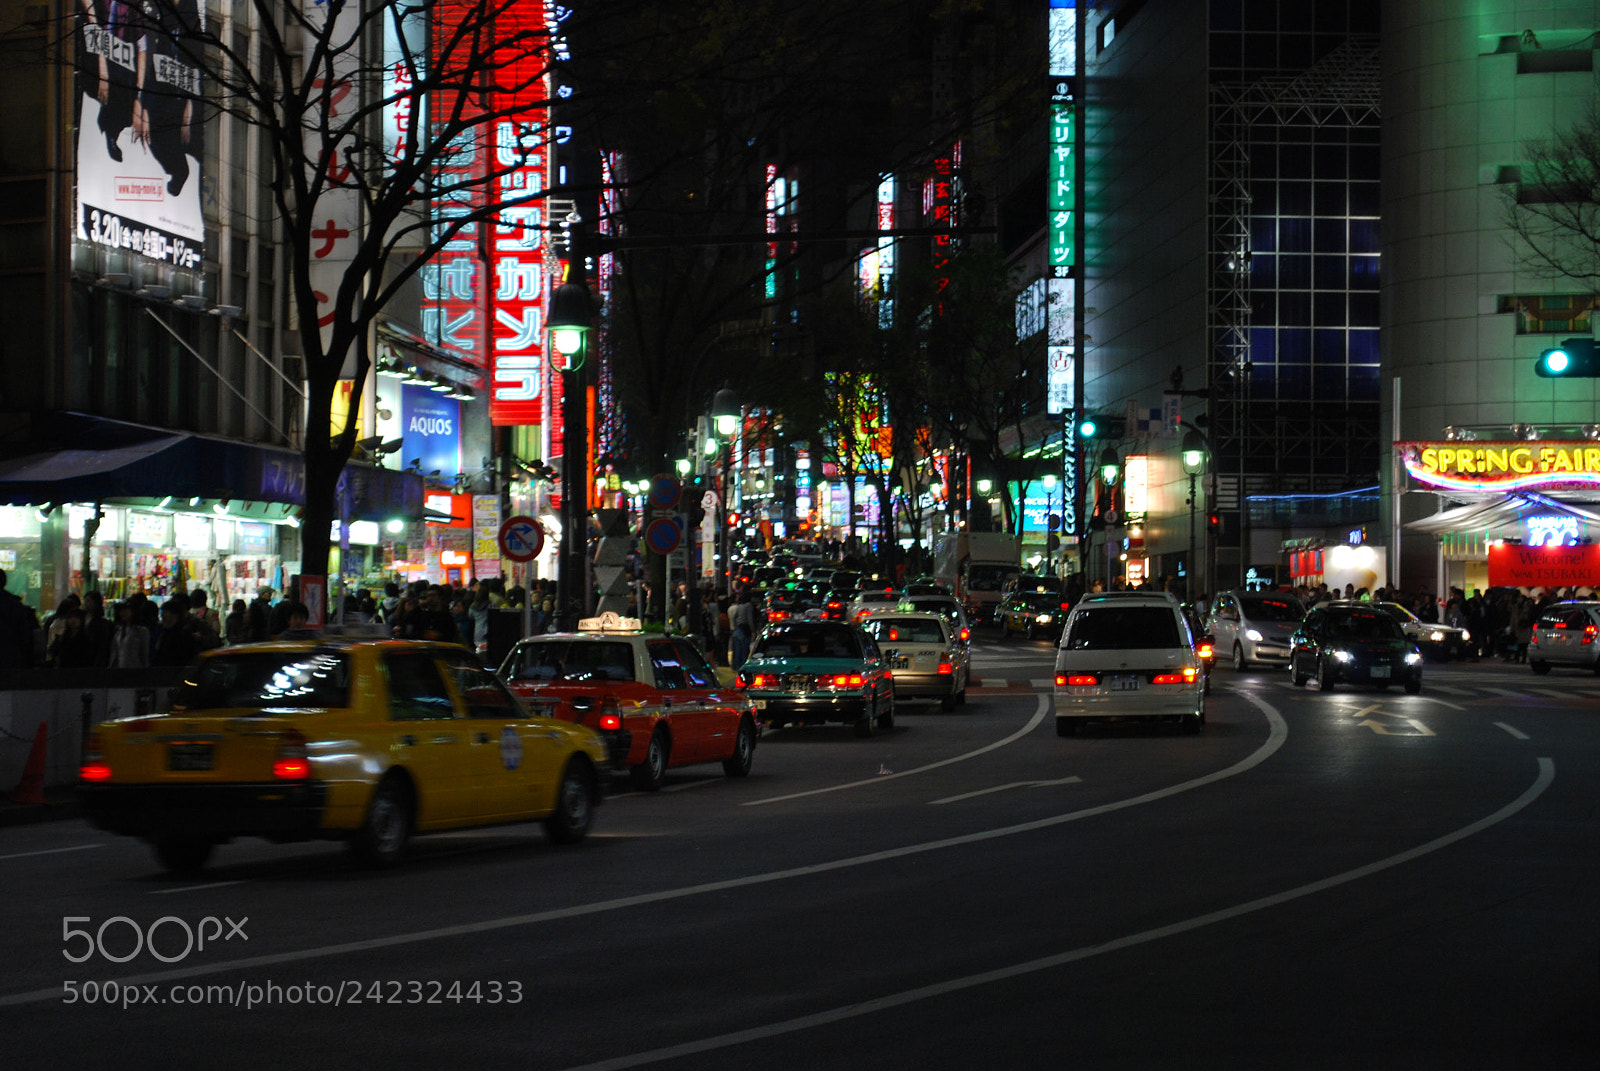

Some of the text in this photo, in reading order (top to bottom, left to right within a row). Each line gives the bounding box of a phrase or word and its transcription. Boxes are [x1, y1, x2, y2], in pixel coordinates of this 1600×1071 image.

[1053, 107, 1071, 263] ビリヤード・ダーツ
[495, 121, 541, 402] ビックカメラ
[1054, 266, 1070, 277] 3F
[409, 416, 453, 437] AQUOS
[1539, 448, 1600, 473] FAIR
[1064, 411, 1076, 534] CONCERT HALL
[705, 493, 713, 505] 3
[1013, 497, 1055, 505] CNCERT
[1106, 512, 1114, 520] 4
[1519, 552, 1585, 565] Welcome!
[1511, 568, 1592, 579] New TSUBAKI
